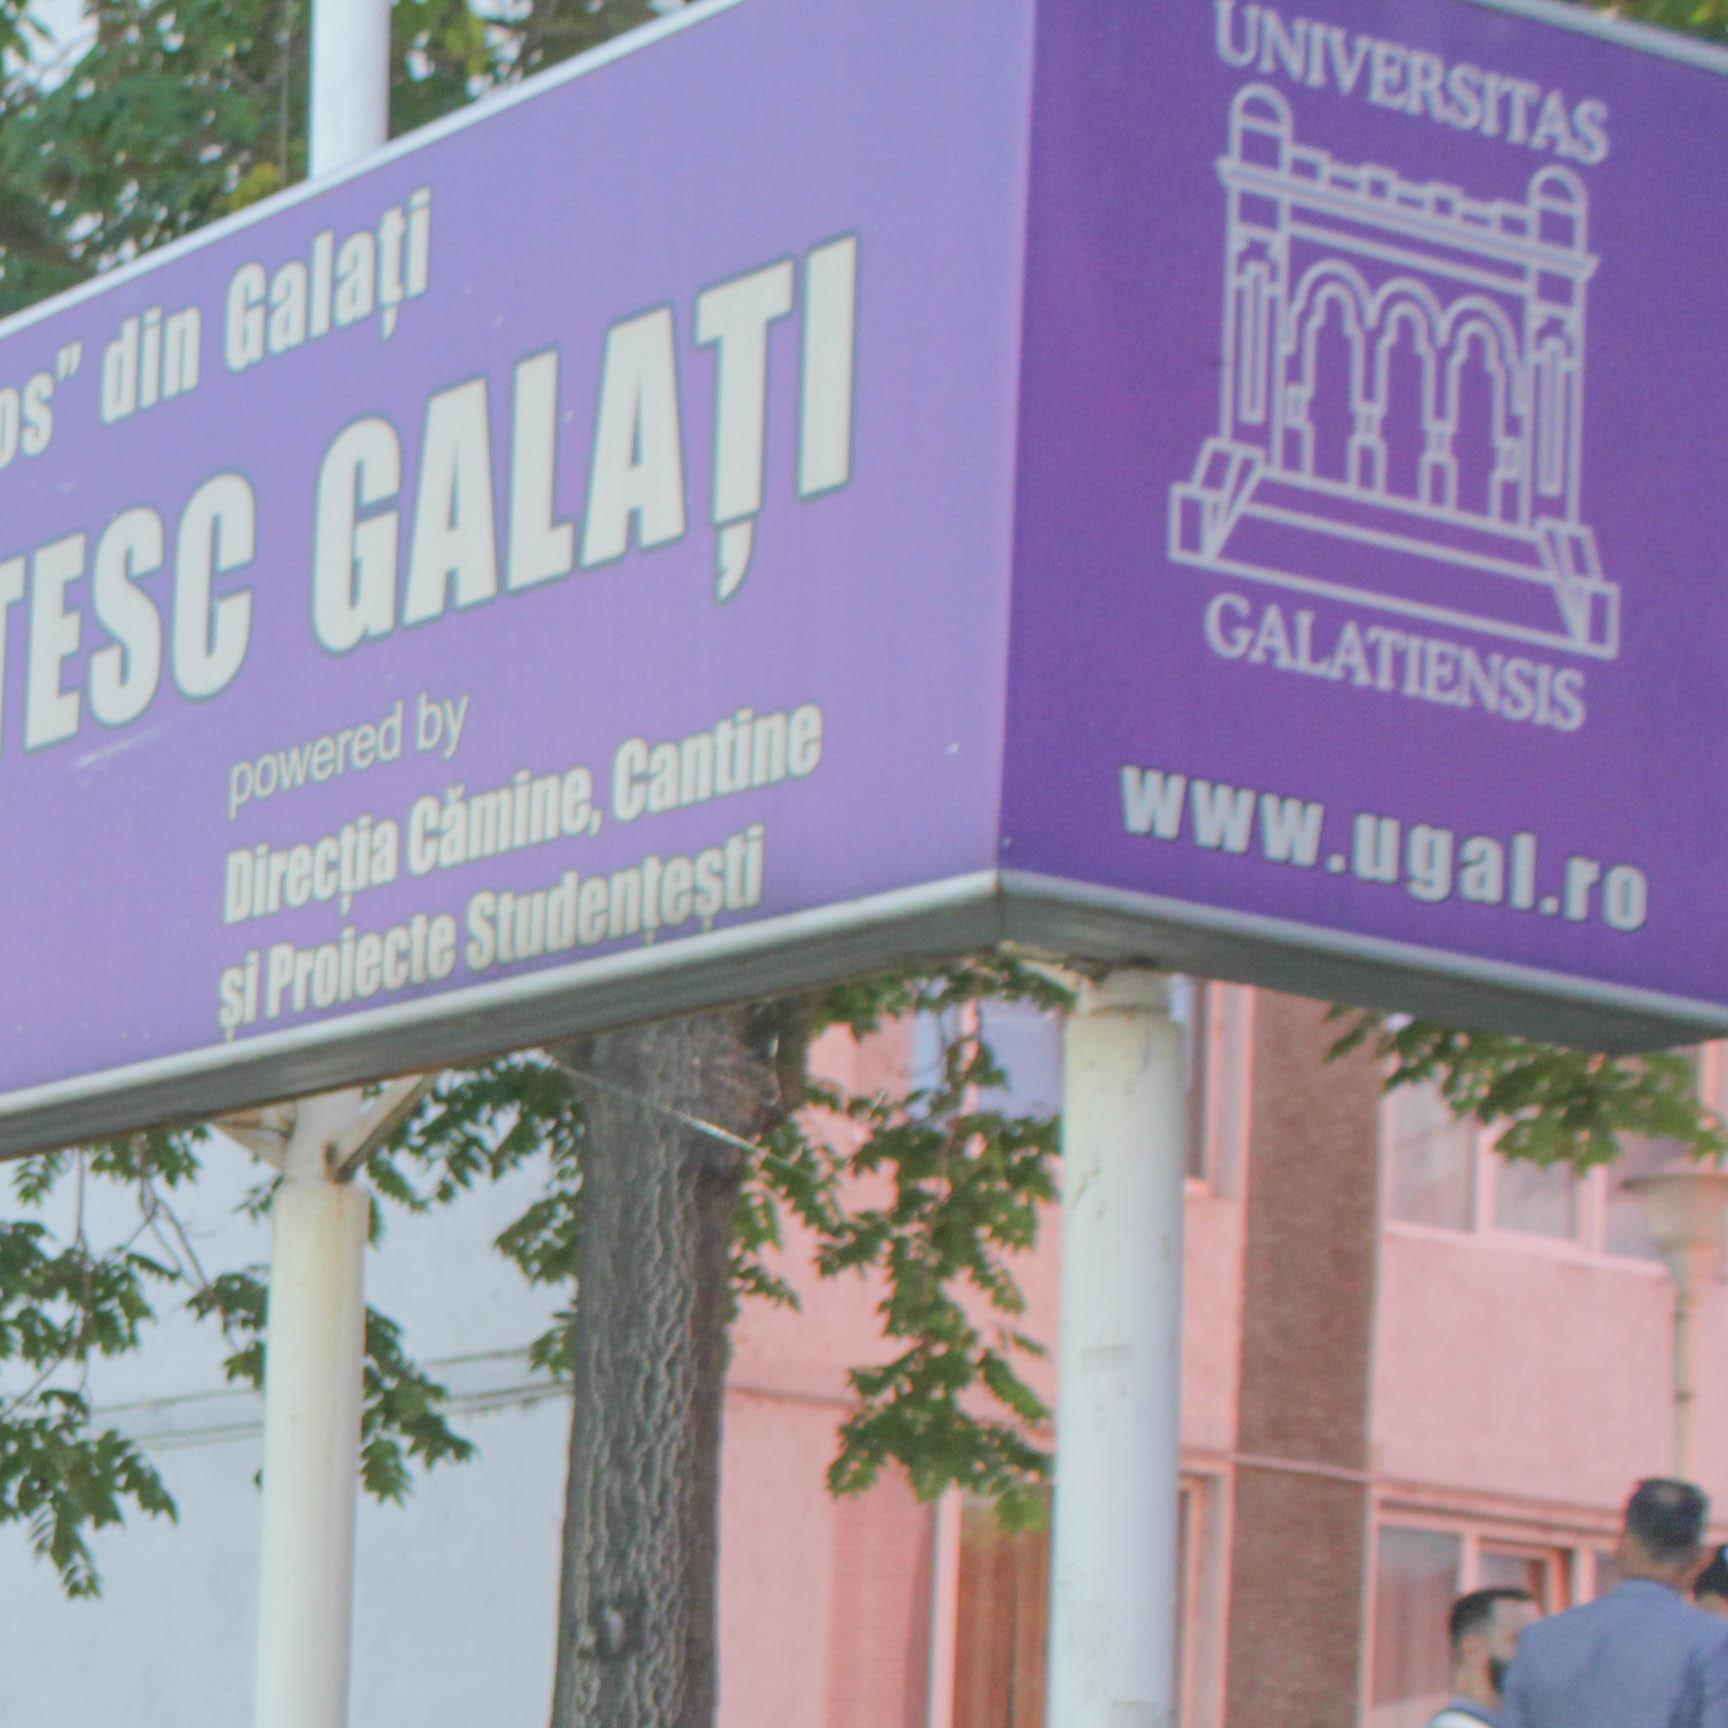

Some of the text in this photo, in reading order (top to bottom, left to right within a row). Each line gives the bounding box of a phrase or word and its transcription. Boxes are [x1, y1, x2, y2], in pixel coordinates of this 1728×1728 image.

[1215, 0, 1609, 165] UNIVERSITAS
[101, 306, 200, 424] din
[225, 186, 430, 372] Galați
[313, 233, 857, 654] GALAȚI
[229, 692, 469, 819] powered by
[1205, 593, 1586, 731] GALATIENSIS
[225, 703, 822, 923] Direcția Cămine, Cantine
[1121, 764, 1646, 930] www.ugal.ro
[219, 825, 763, 1041] și Proiecte Studențești
